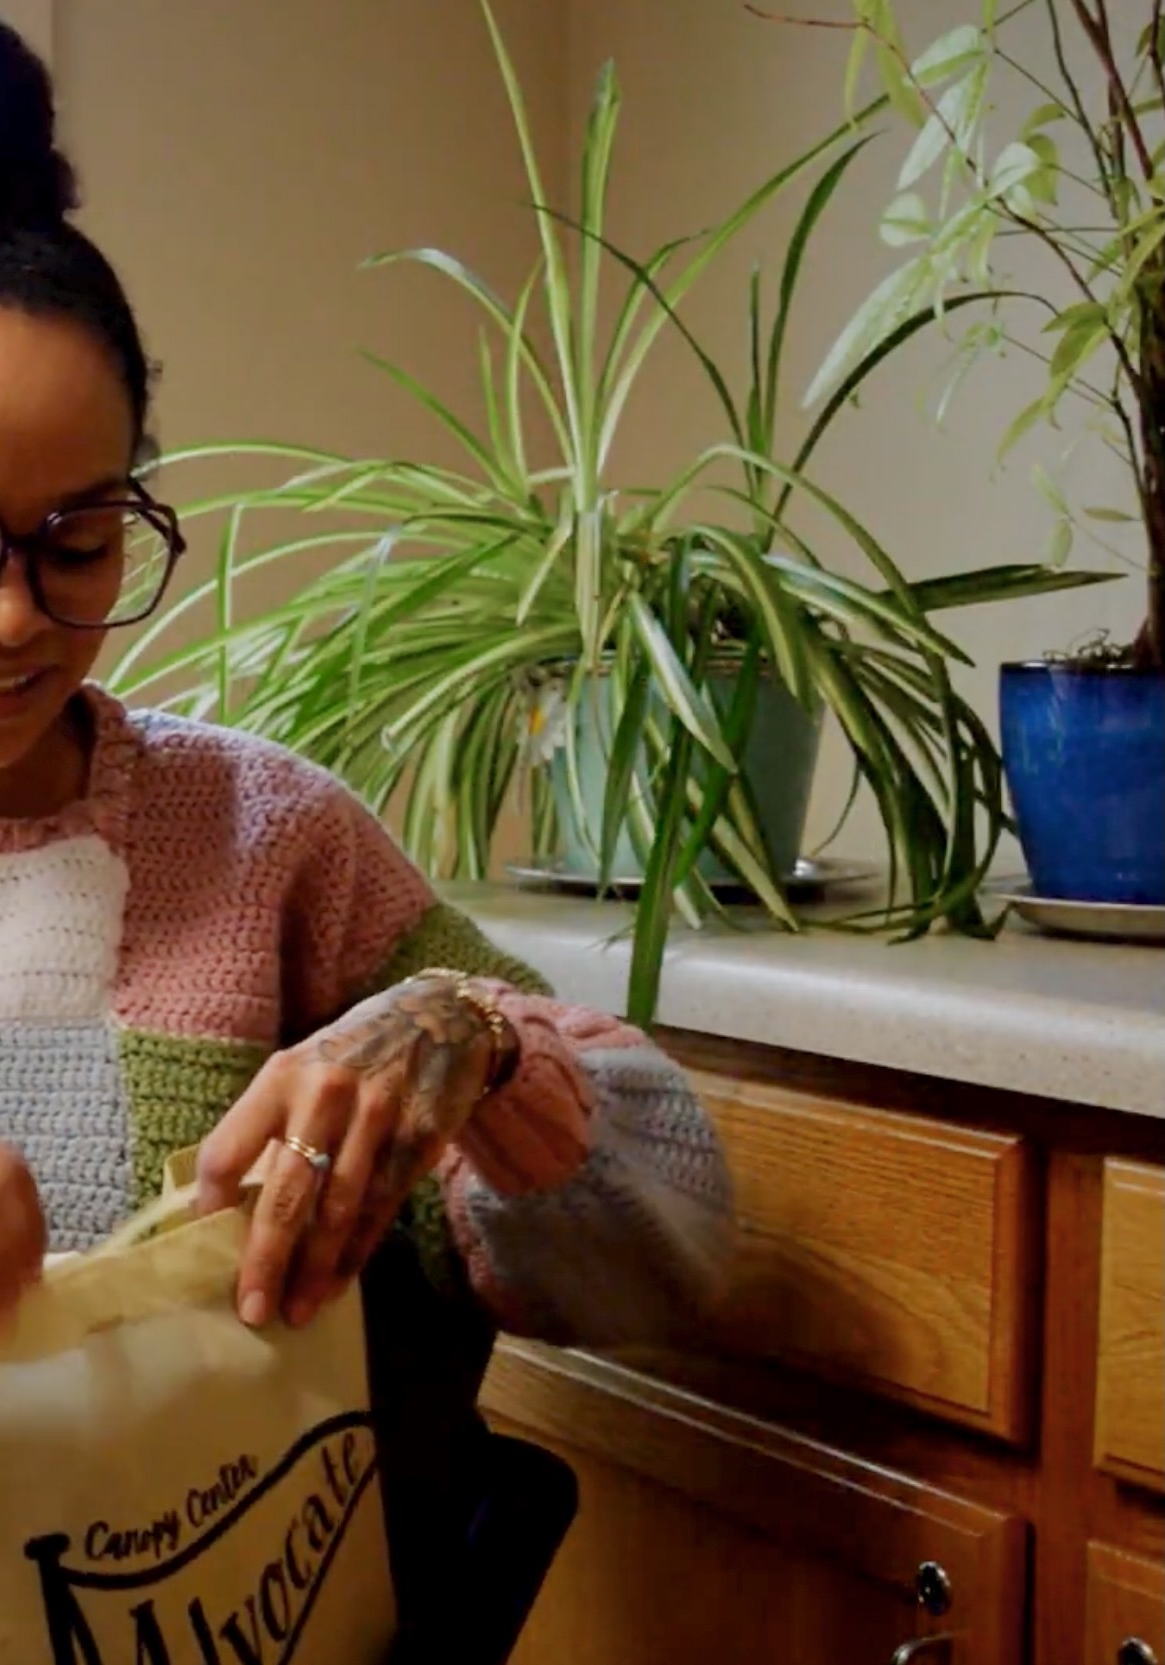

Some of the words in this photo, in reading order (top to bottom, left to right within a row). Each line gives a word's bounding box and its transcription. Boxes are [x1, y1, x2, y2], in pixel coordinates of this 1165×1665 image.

[84, 1509, 180, 1561] Canopy
[185, 1454, 258, 1527] Center
[130, 1432, 364, 1665] vocate
